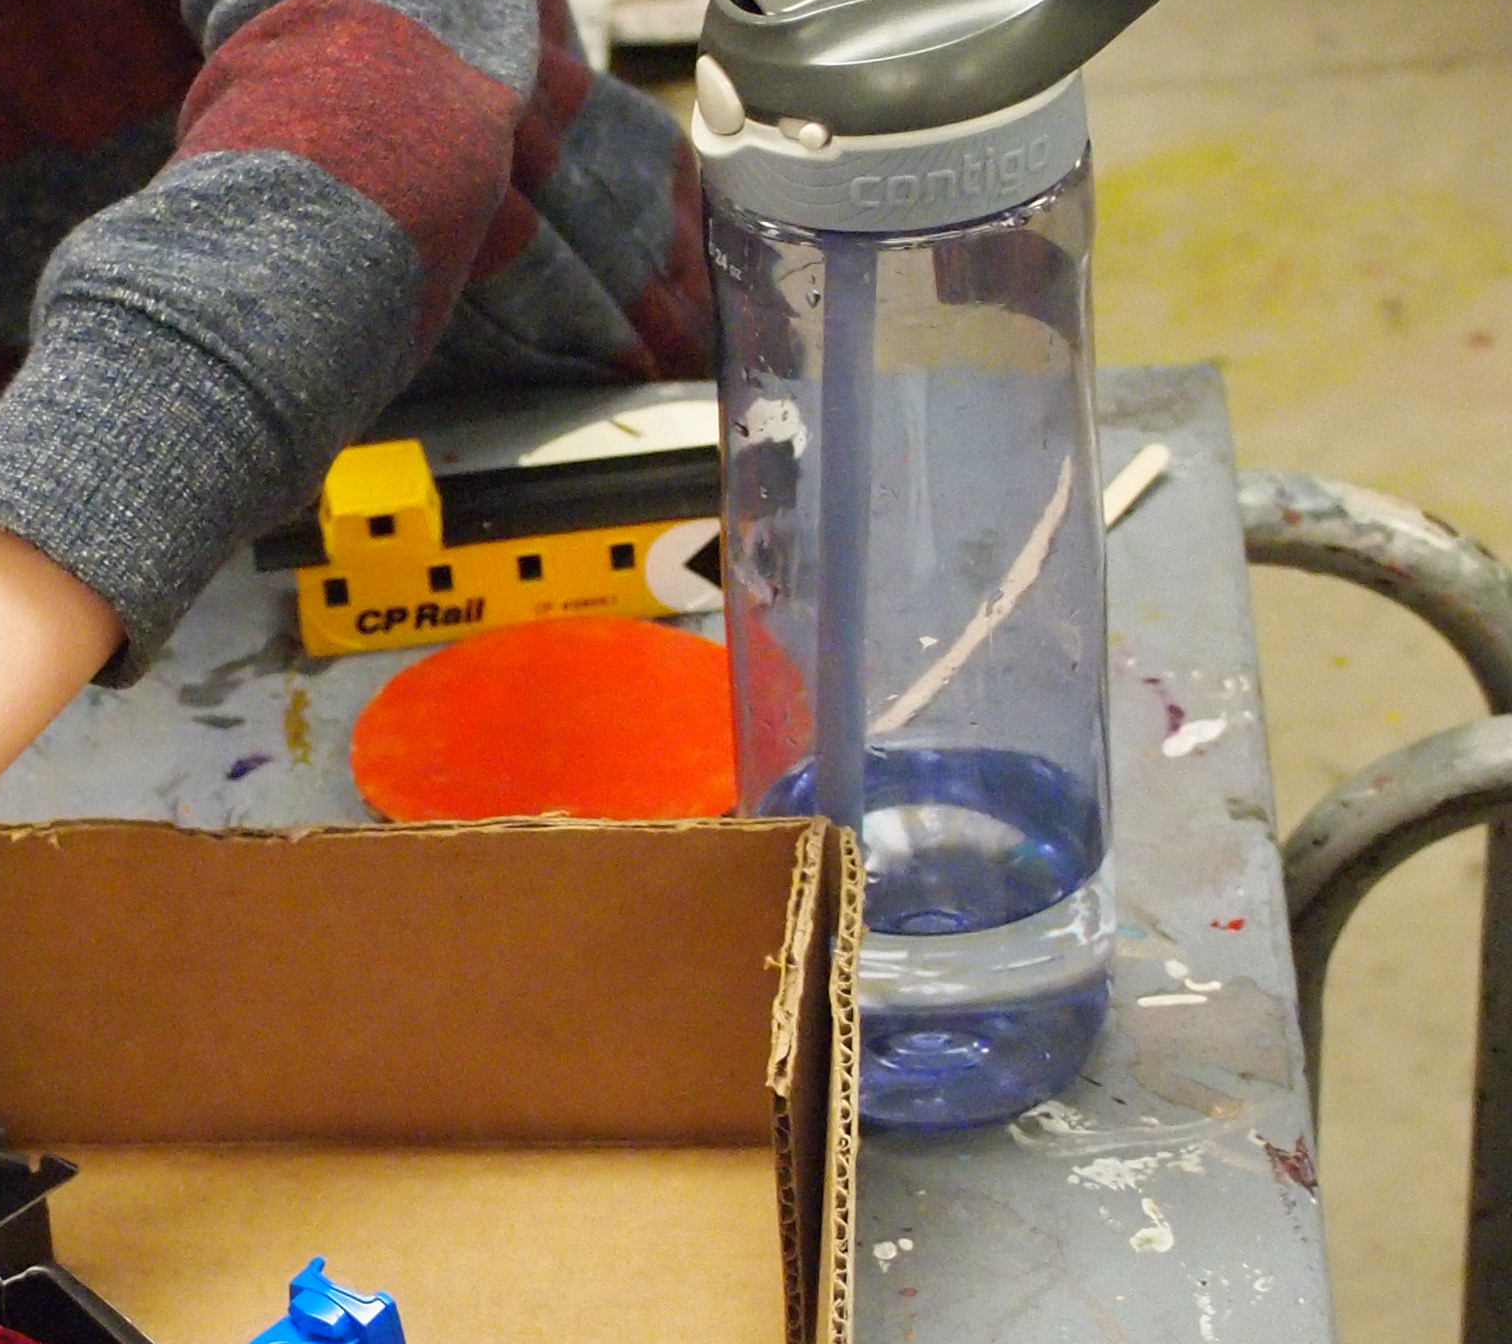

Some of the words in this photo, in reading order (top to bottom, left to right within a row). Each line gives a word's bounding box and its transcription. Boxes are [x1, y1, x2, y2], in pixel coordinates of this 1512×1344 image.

[850, 133, 1051, 209] contigo
[356, 606, 408, 636] CP
[414, 596, 485, 631] Rail
